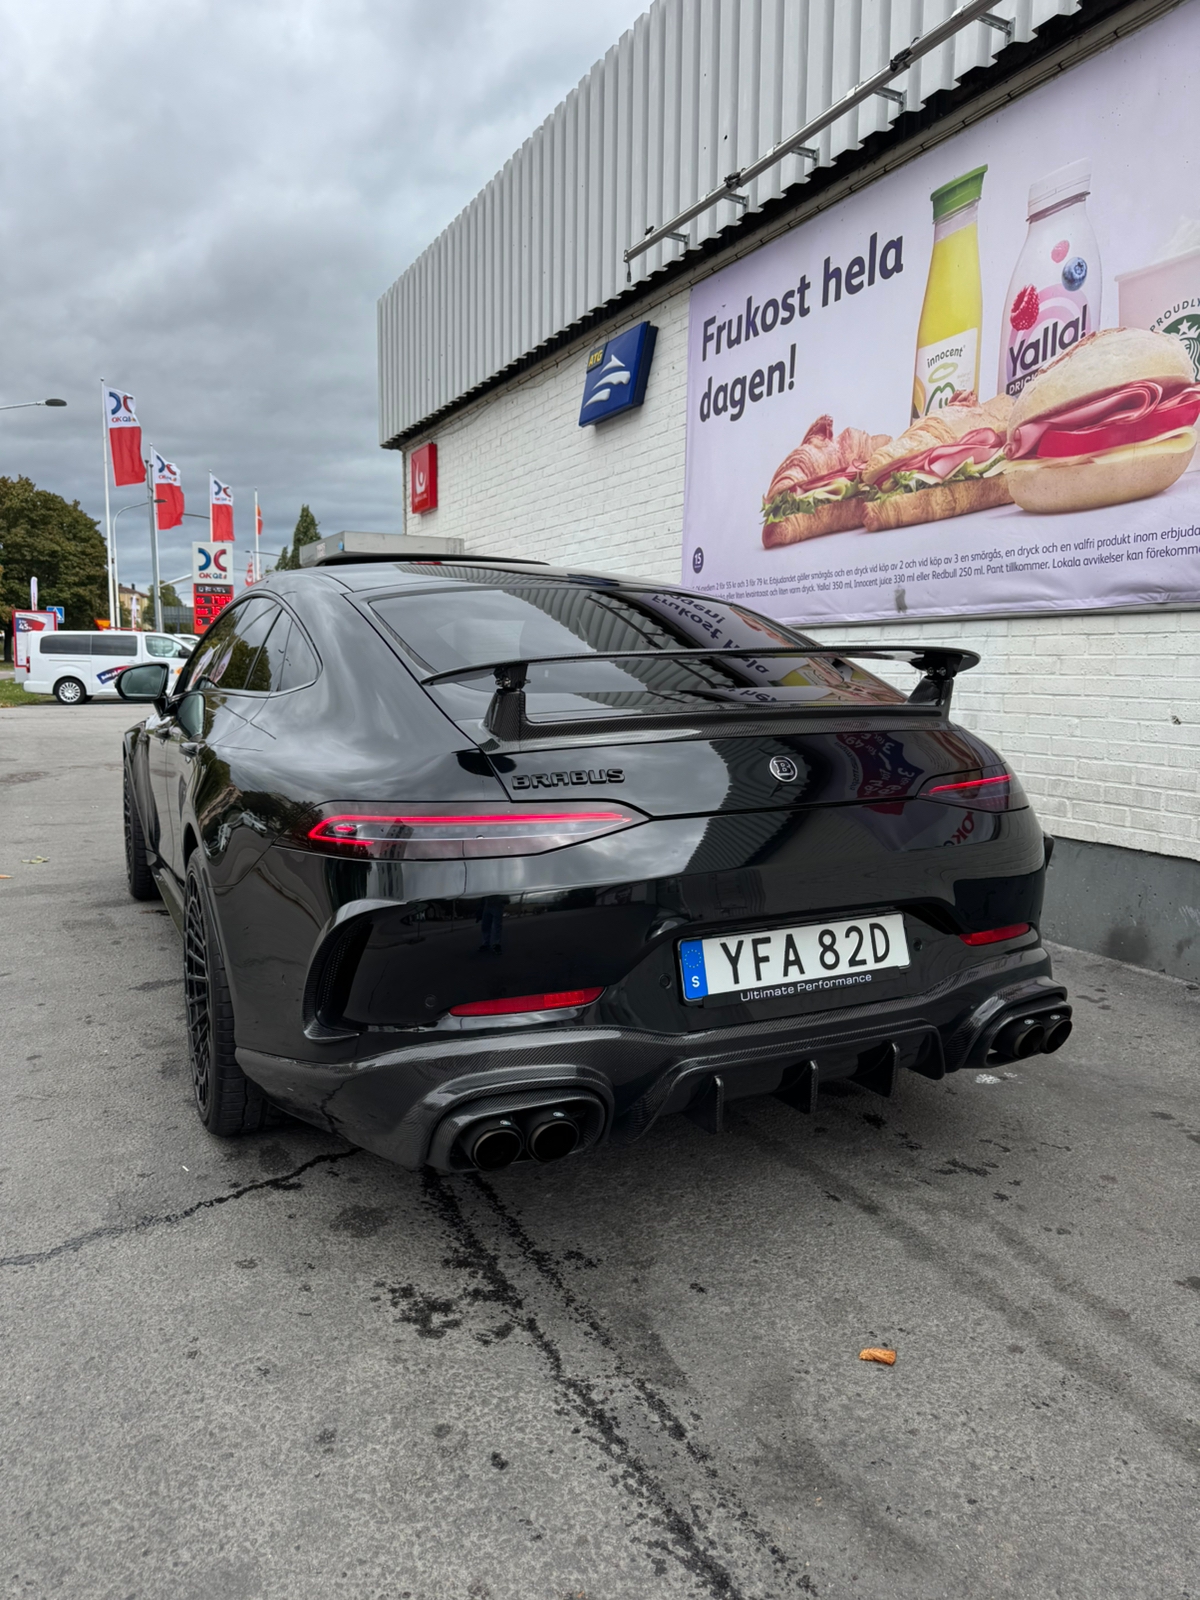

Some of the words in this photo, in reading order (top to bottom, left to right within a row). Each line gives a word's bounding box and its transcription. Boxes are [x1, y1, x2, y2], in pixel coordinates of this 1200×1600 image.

[702, 274, 811, 362] Frukost
[822, 232, 904, 308] hela
[588, 349, 603, 367] ATG
[927, 346, 963, 368] innocent
[1009, 304, 1087, 377] Yalla!
[700, 343, 796, 422] dagen!
[694, 552, 702, 564] 15
[769, 574, 796, 586] Erbjudandet
[797, 572, 810, 583] gäller
[810, 569, 834, 582] smörgås
[834, 568, 845, 578] och
[846, 568, 853, 576] en
[854, 564, 869, 577] dryck
[869, 564, 878, 574] vid
[879, 563, 889, 574] köp
[890, 563, 898, 571] av
[899, 560, 904, 570] 2
[905, 560, 917, 569] och
[918, 557, 928, 568] vid
[930, 556, 942, 568] köp
[944, 557, 952, 565] av
[954, 554, 958, 563] 3
[961, 554, 969, 562] en
[971, 548, 1003, 562] smörgås,
[1005, 549, 1015, 558] en
[1017, 544, 1040, 558] dryck
[1042, 542, 1058, 554] och
[1060, 542, 1071, 552] en
[1074, 538, 1094, 550] valfri
[1097, 534, 1131, 550] produkt
[1133, 532, 1158, 543] inom
[802, 584, 815, 595] dryck.
[816, 582, 831, 592] Yalla!
[832, 580, 843, 590] 350
[854, 578, 878, 588] Innocent
[878, 576, 892, 588] juice
[894, 574, 905, 584] 330
[907, 572, 915, 582] ml
[916, 571, 930, 582] eller
[932, 568, 958, 580] Redbull
[959, 567, 972, 578] 250
[974, 566, 985, 575] ml.
[987, 564, 1004, 574] Pant
[1006, 561, 1050, 572] tillkommer.
[1052, 556, 1080, 568] Lokala
[1083, 552, 1124, 566] avvikelser
[1126, 550, 1143, 561] kan
[1146, 545, 1200, 559] förekomm
[511, 768, 625, 790] BRABUS
[720, 933, 806, 985] YFA
[818, 922, 891, 971] 82D
[691, 976, 700, 988] S
[740, 985, 795, 1001] Ultimate
[797, 972, 872, 992] Performance
